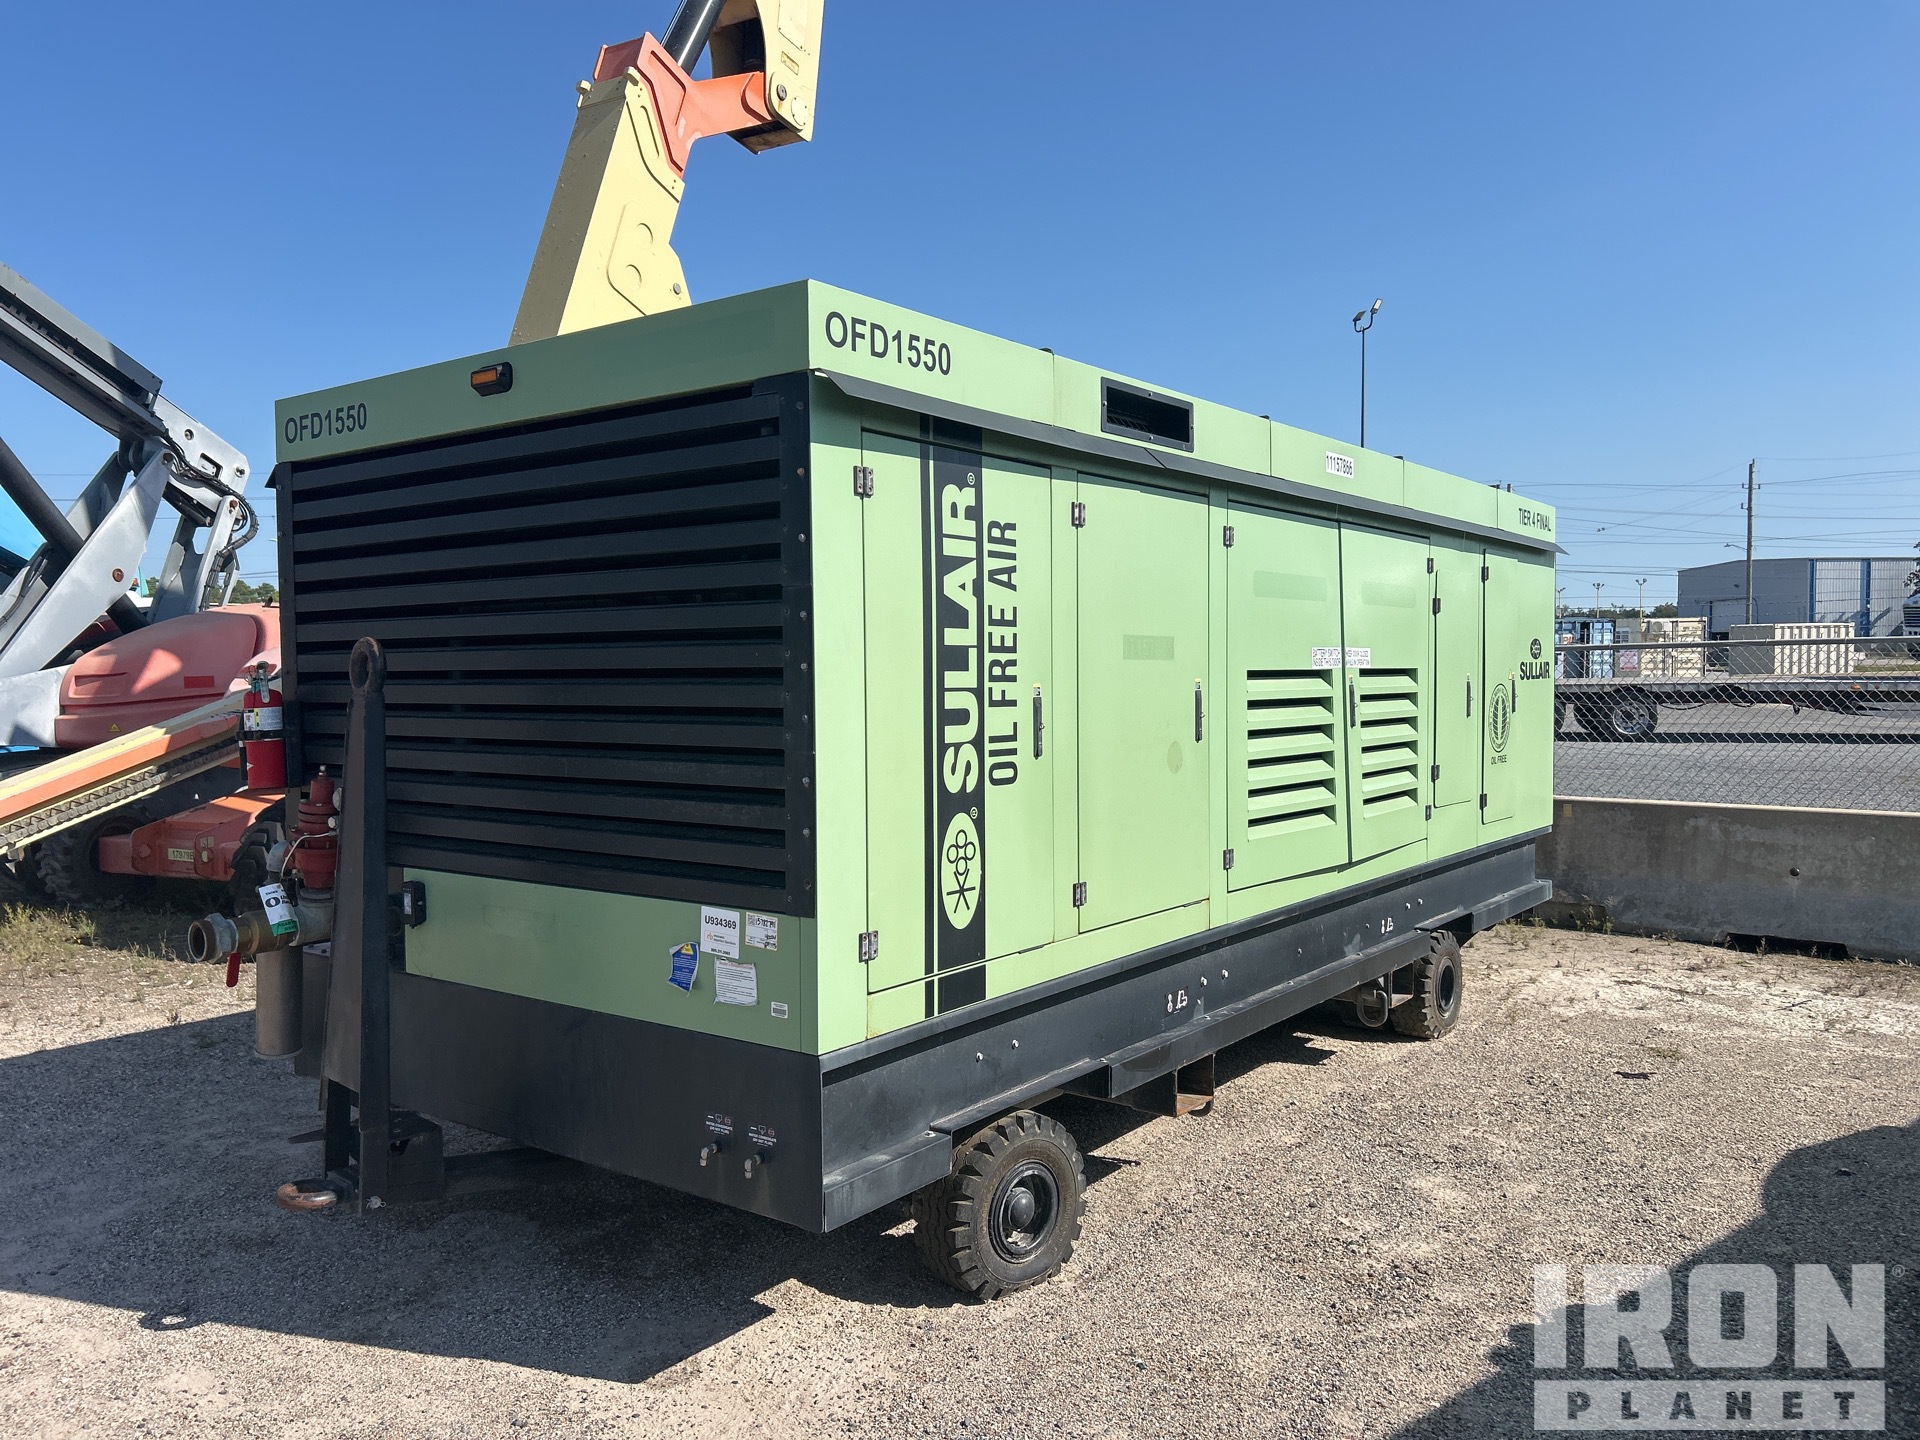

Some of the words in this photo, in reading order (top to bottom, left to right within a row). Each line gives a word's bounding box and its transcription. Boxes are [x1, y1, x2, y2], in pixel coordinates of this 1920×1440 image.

[825, 311, 951, 376] OFD1550
[284, 402, 367, 444] OFD1550
[1326, 455, 1353, 476] 11157866
[1518, 507, 1531, 527] TIER
[1532, 511, 1536, 528] 4
[1537, 512, 1551, 532] FINAL
[987, 520, 1017, 592] AIR
[941, 483, 977, 794] SULLAIR
[987, 604, 1018, 707] FREE
[1520, 661, 1550, 681] SULLAIR
[988, 721, 1018, 786] OIL
[1498, 754, 1507, 764] FREE
[704, 915, 737, 930] U934369
